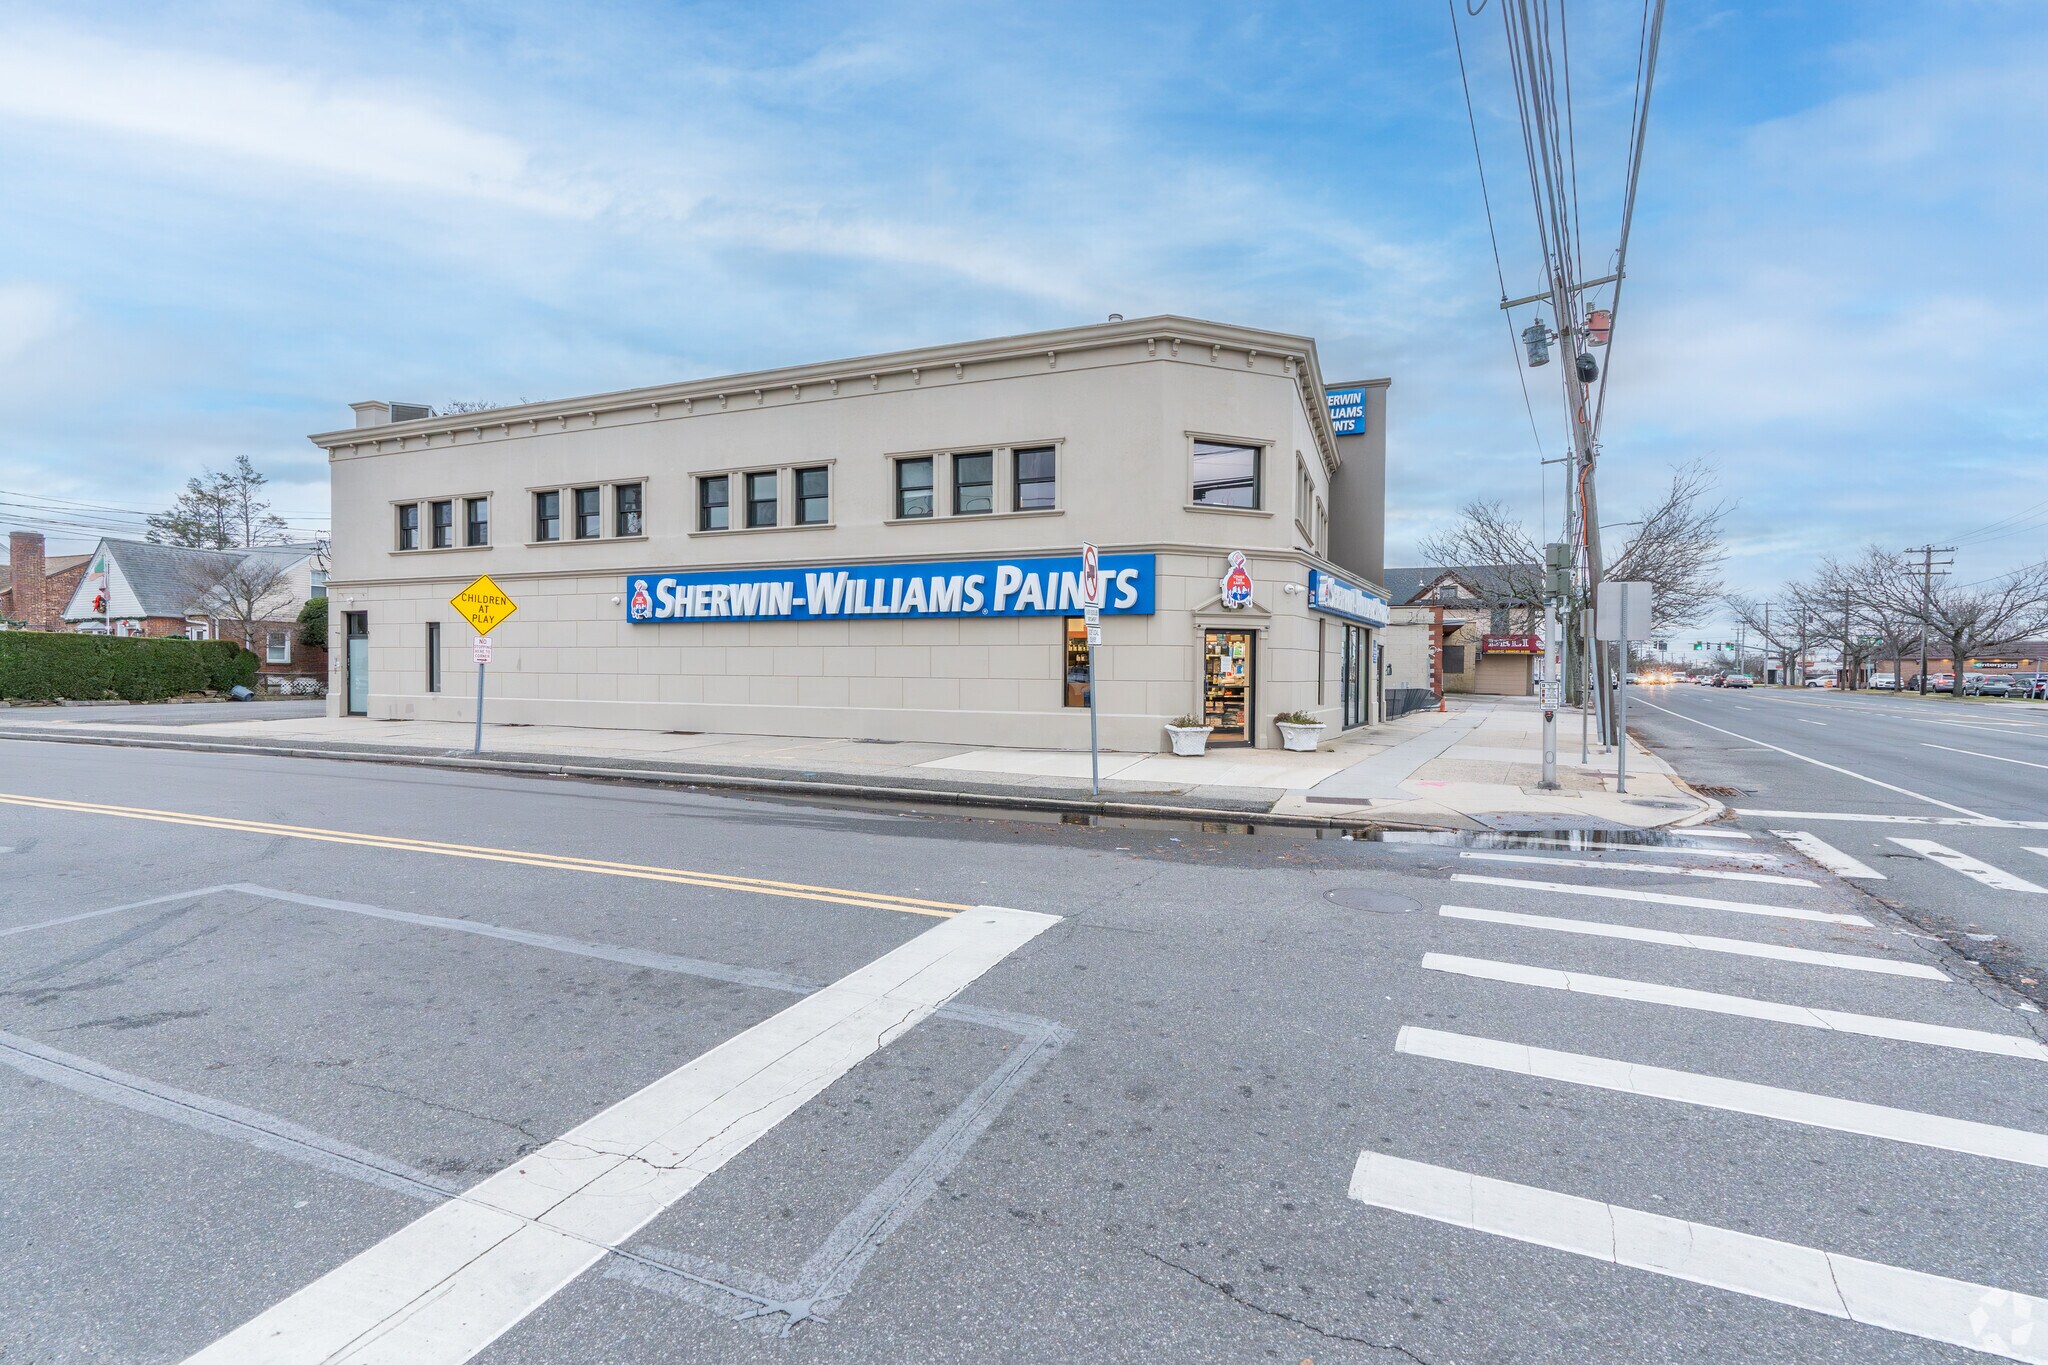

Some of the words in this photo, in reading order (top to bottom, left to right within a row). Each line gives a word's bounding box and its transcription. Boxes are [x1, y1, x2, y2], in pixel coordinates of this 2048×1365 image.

[1326, 393, 1361, 406] ERWIN
[1331, 406, 1363, 419] LIAMS
[655, 571, 984, 618] SHERWIN-WILLIAMS
[993, 565, 1139, 611] PAINTS
[461, 593, 507, 605] CHILDREN
[478, 605, 489, 613] AT
[472, 614, 495, 624] PLAY
